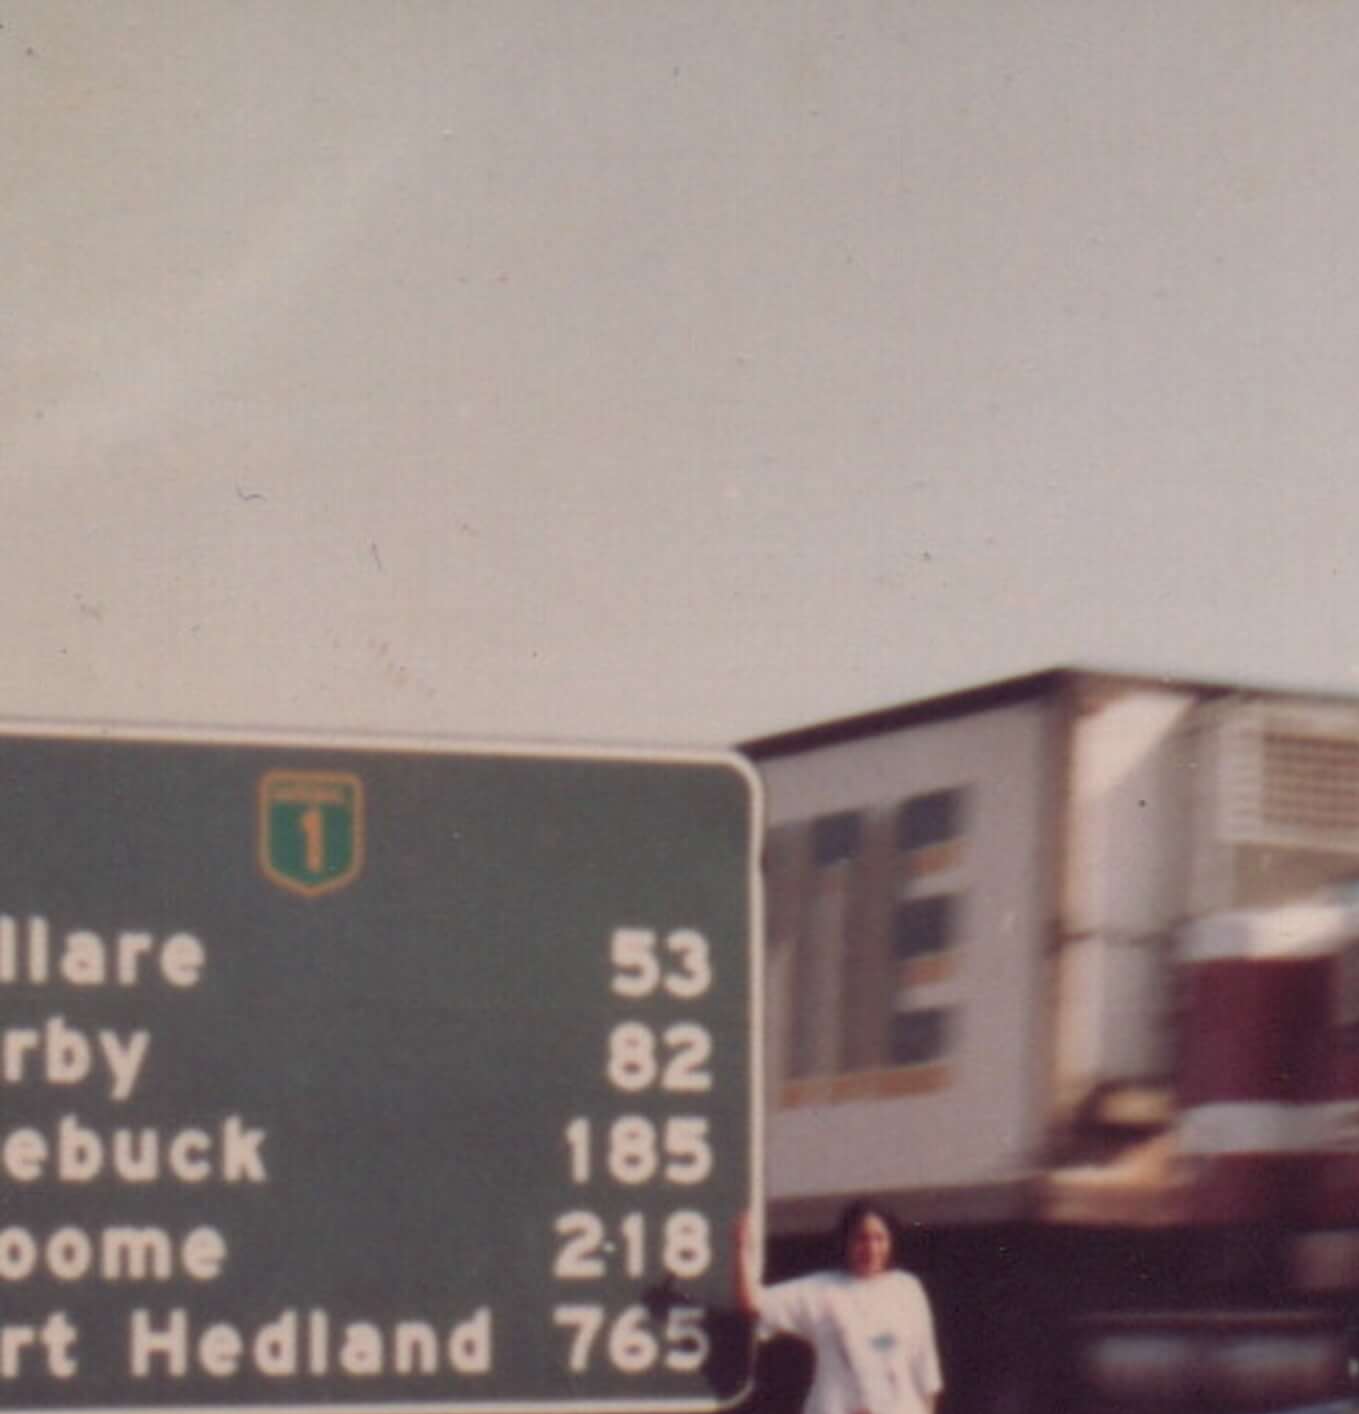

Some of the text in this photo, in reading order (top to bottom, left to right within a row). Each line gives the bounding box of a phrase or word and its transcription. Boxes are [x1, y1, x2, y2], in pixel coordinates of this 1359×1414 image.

[301, 810, 323, 872] 1
[611, 928, 712, 998] 53
[3, 1017, 712, 1100] rby 82
[4, 1115, 712, 1184] ebuck 185
[554, 1210, 711, 1277] 218
[132, 1309, 491, 1376] Hedland
[554, 1305, 709, 1371] 765
